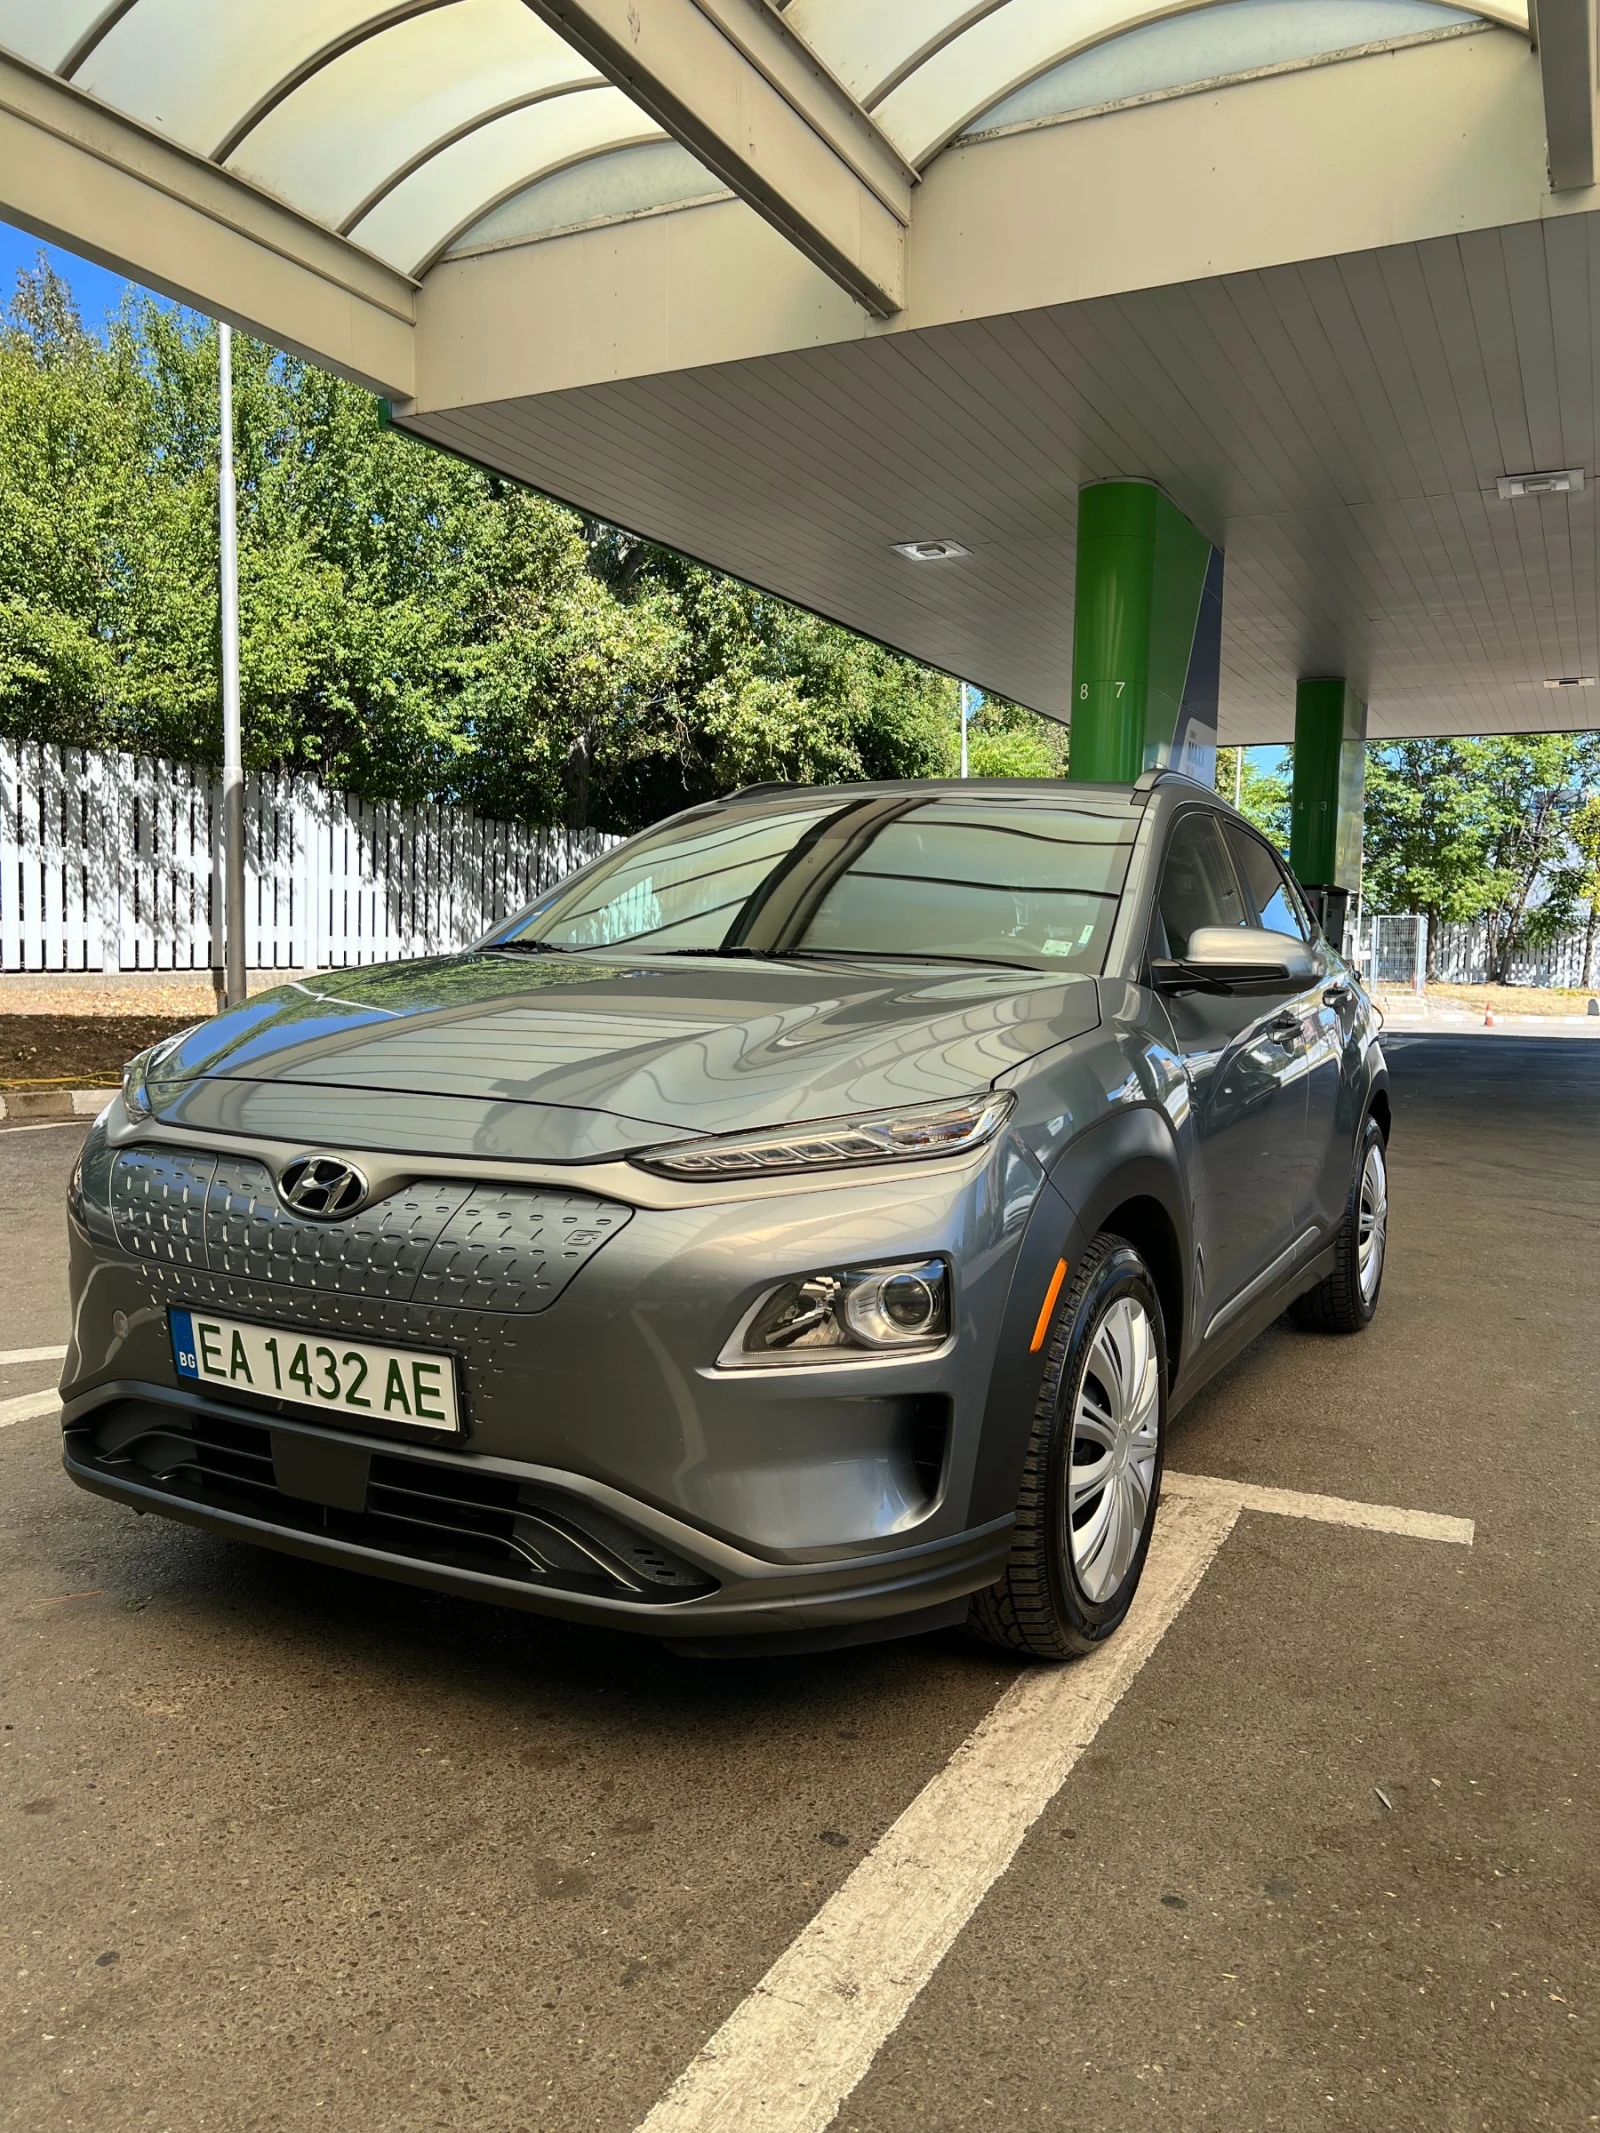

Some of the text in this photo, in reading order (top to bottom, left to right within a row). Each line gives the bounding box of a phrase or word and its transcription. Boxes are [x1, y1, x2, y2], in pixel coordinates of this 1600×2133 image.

[1080, 682, 1126, 700] 8 7
[1298, 801, 1327, 811] 4 3
[179, 1351, 196, 1369] BG
[198, 1322, 447, 1421] EA 1432 AE
